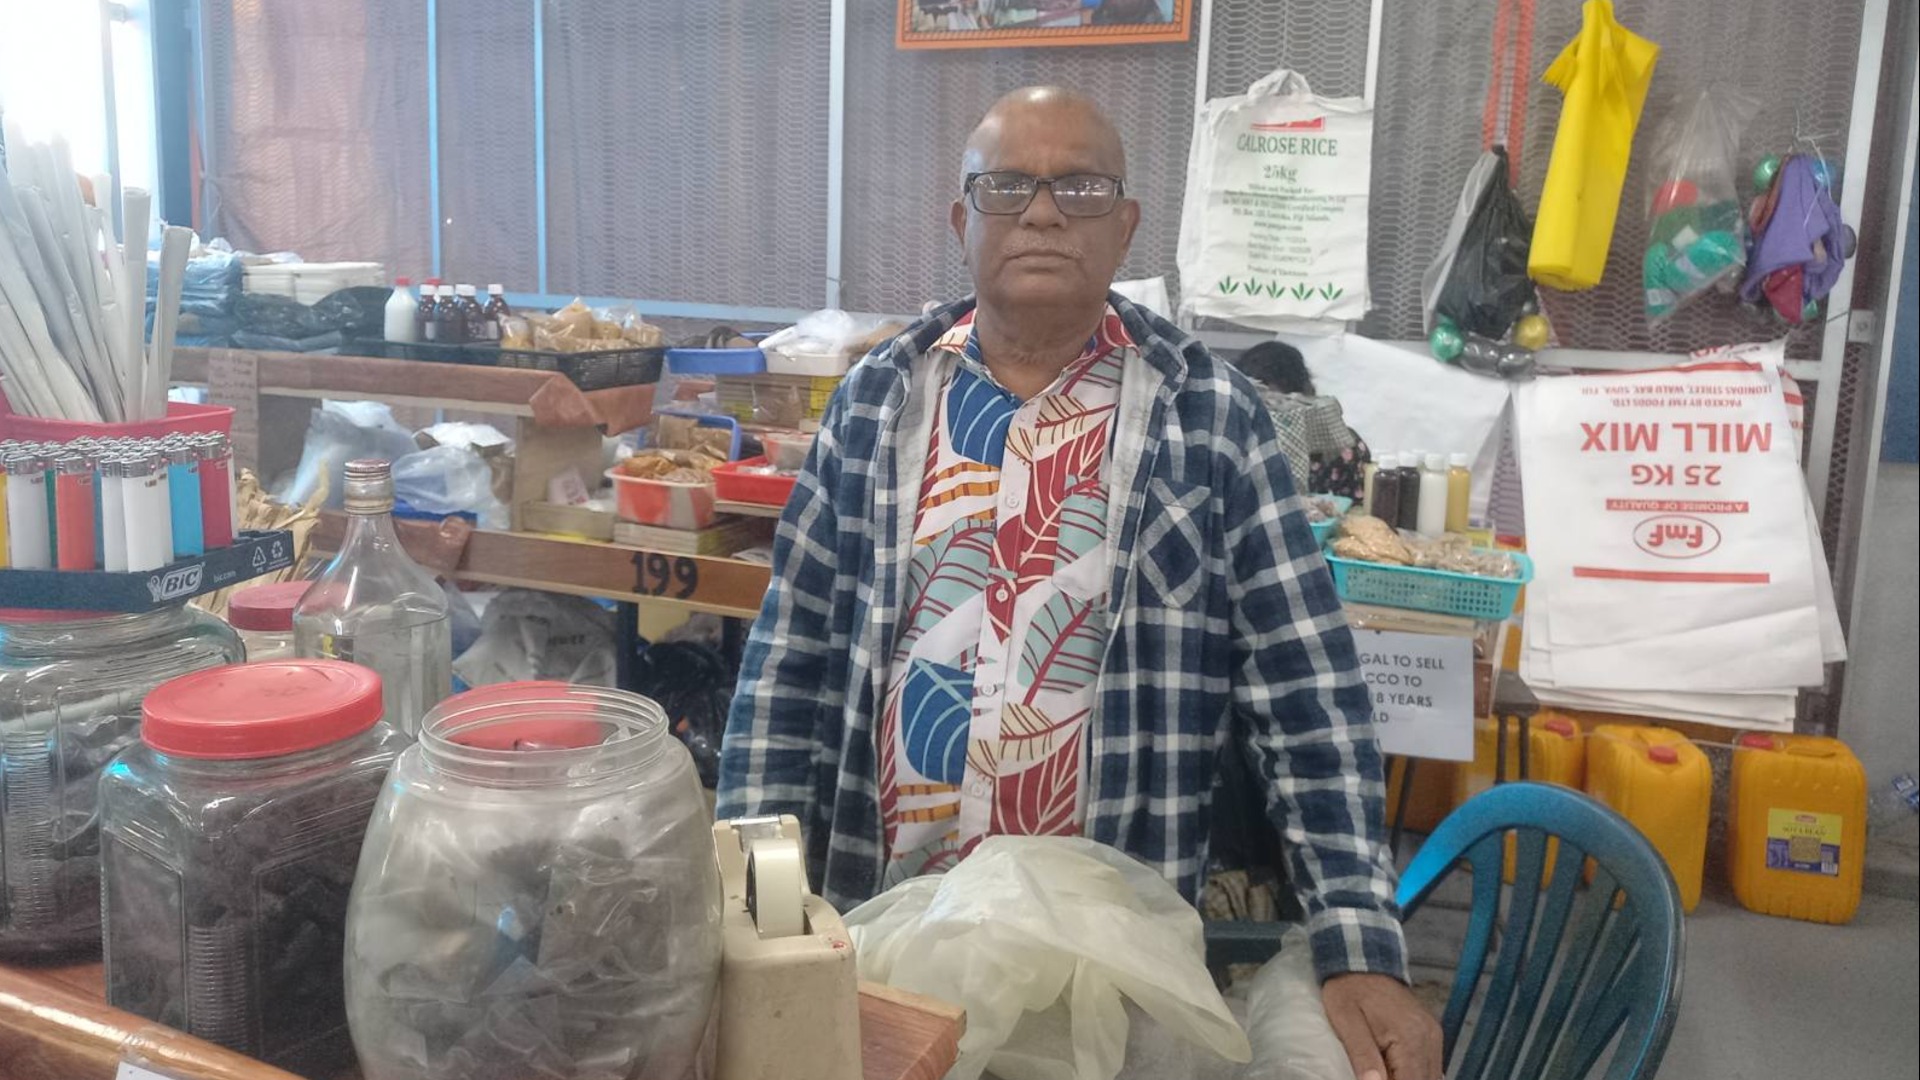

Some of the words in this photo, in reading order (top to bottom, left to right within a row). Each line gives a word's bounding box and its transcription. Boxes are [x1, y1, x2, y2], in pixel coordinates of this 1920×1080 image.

[1236, 133, 1297, 155] CALROSE
[1301, 137, 1338, 157] RICE
[1263, 164, 1299, 183] 25kg
[1633, 398, 1664, 408] FOODS
[1690, 399, 1702, 408] BY
[1704, 399, 1742, 408] PACKED
[1580, 423, 1659, 452] MIX
[1672, 423, 1772, 452] MILL
[1631, 464, 1673, 486] KG
[1685, 465, 1722, 486] 25
[1611, 501, 1660, 511] QUALITY
[1663, 501, 1678, 511] OF
[1682, 502, 1733, 512] PROMISE
[1734, 503, 1745, 512] A
[631, 551, 699, 601] 199
[1360, 652, 1389, 666] GAL
[1393, 655, 1411, 668] TO
[1416, 657, 1445, 670] SELL
[1365, 672, 1399, 686] CCO
[1403, 674, 1422, 688] TO
[1376, 691, 1385, 704] 8
[1389, 693, 1433, 708] YEARS
[1373, 711, 1389, 724] LD
